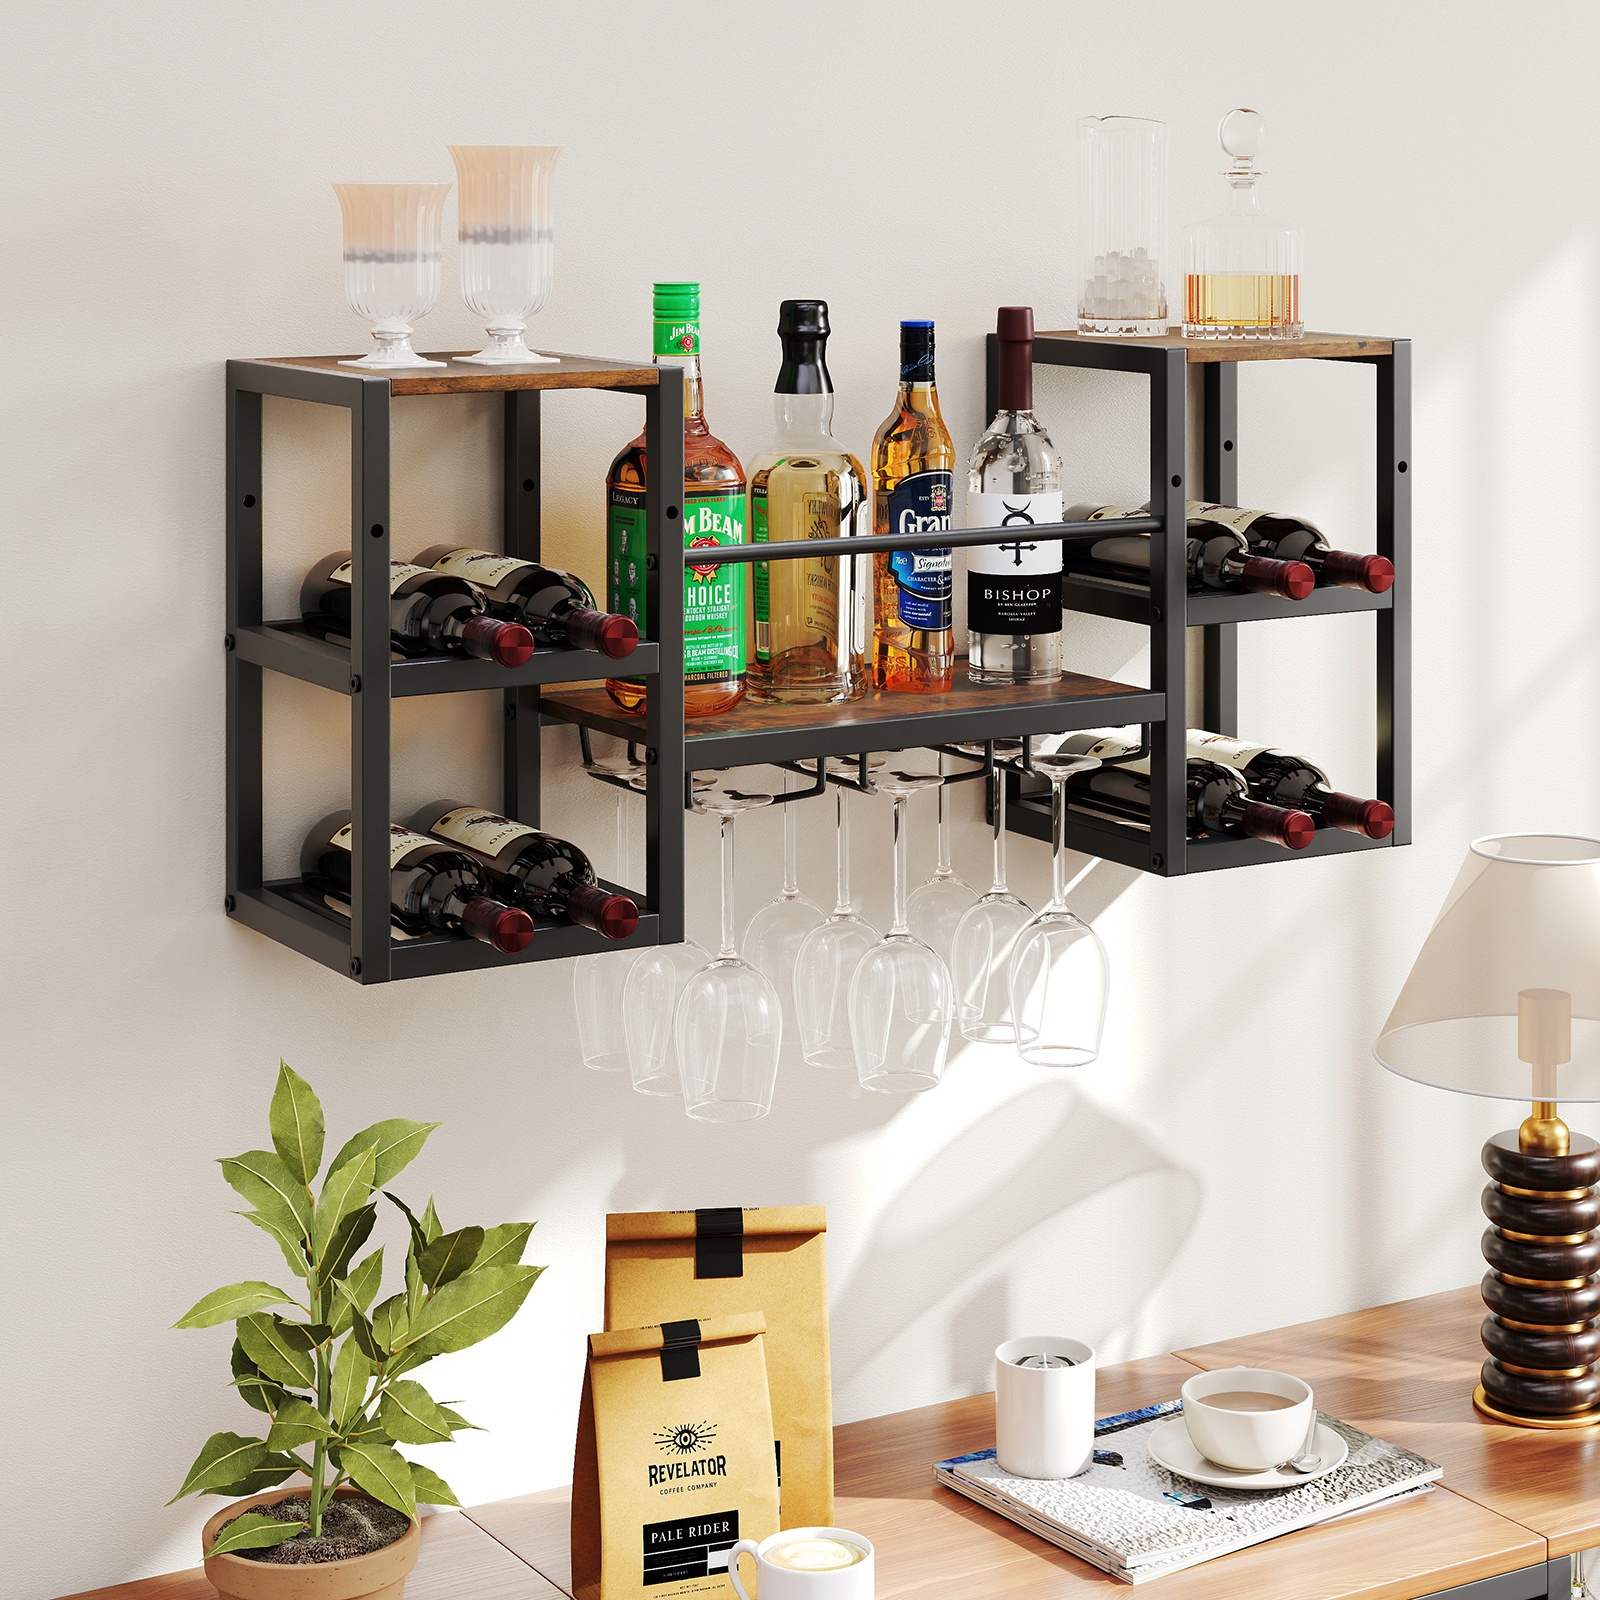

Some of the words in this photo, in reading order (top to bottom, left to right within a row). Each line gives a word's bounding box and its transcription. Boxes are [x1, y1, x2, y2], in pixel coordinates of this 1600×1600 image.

[670, 326, 685, 340] JIM
[612, 491, 639, 505] LEGACY
[698, 507, 742, 544] BEAM
[906, 575, 937, 583] CHARACTER
[937, 574, 944, 585] &
[685, 584, 731, 607] HOICE
[984, 588, 1052, 600] BISHOP
[684, 607, 706, 615] ENTUCKY
[707, 604, 730, 613] STRAIGHT
[684, 614, 706, 622] OURBON
[706, 612, 728, 620] WHISKEY
[692, 649, 706, 657] BEAM
[684, 672, 706, 681] HARCOAL
[706, 671, 729, 679] FILTERED
[648, 1455, 727, 1487] REVELATOR
[659, 1487, 684, 1496] COFFEE
[687, 1481, 718, 1492] COMPANY
[651, 1528, 684, 1544] PALE
[688, 1521, 730, 1538] RIDER
